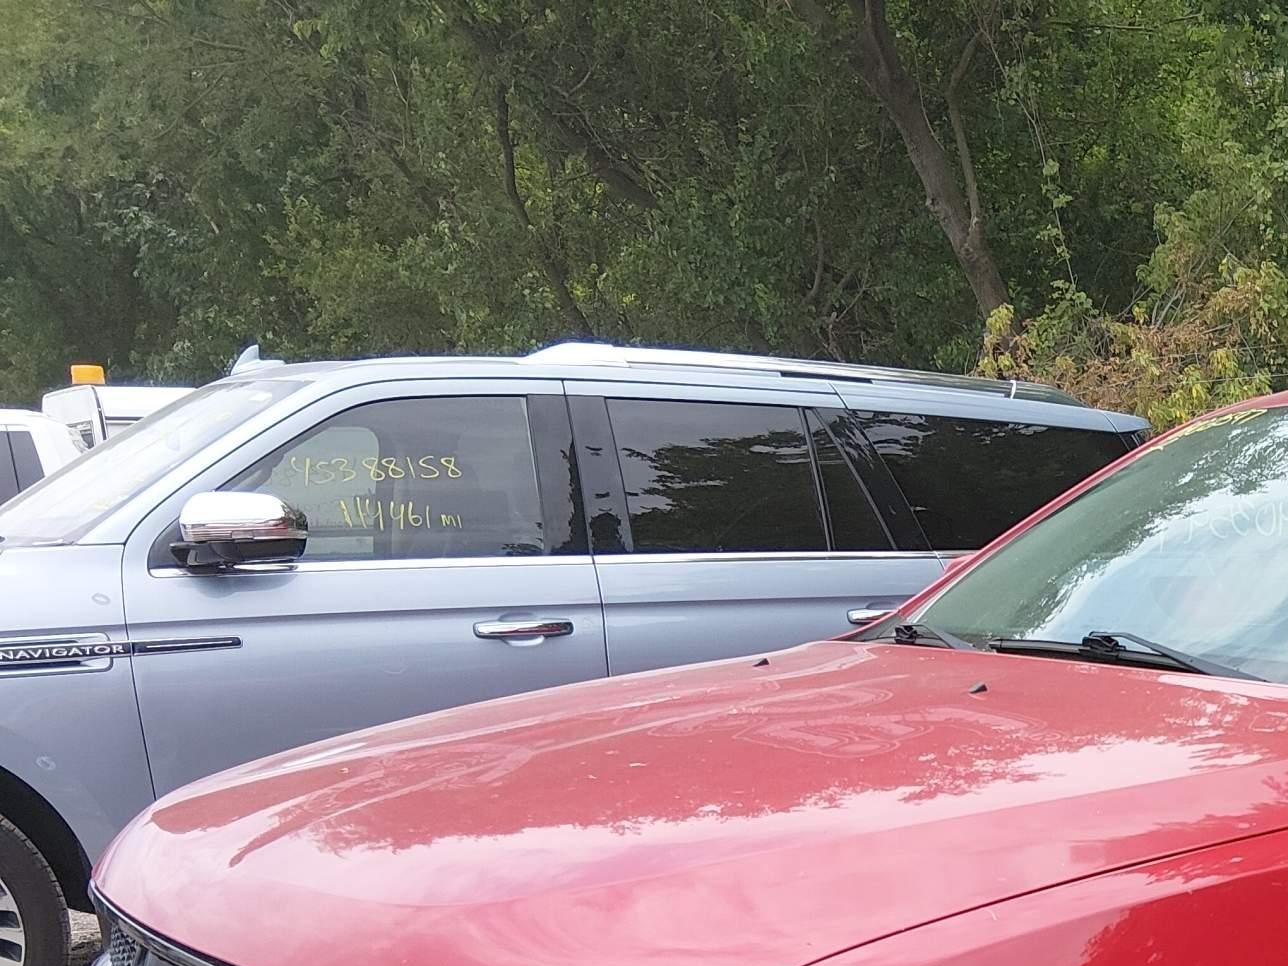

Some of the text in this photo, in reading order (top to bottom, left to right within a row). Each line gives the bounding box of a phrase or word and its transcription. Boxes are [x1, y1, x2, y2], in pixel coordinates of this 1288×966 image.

[290, 455, 462, 487] 45388158
[340, 496, 431, 530] 114461
[0, 644, 125, 660] NAVIGATOR
